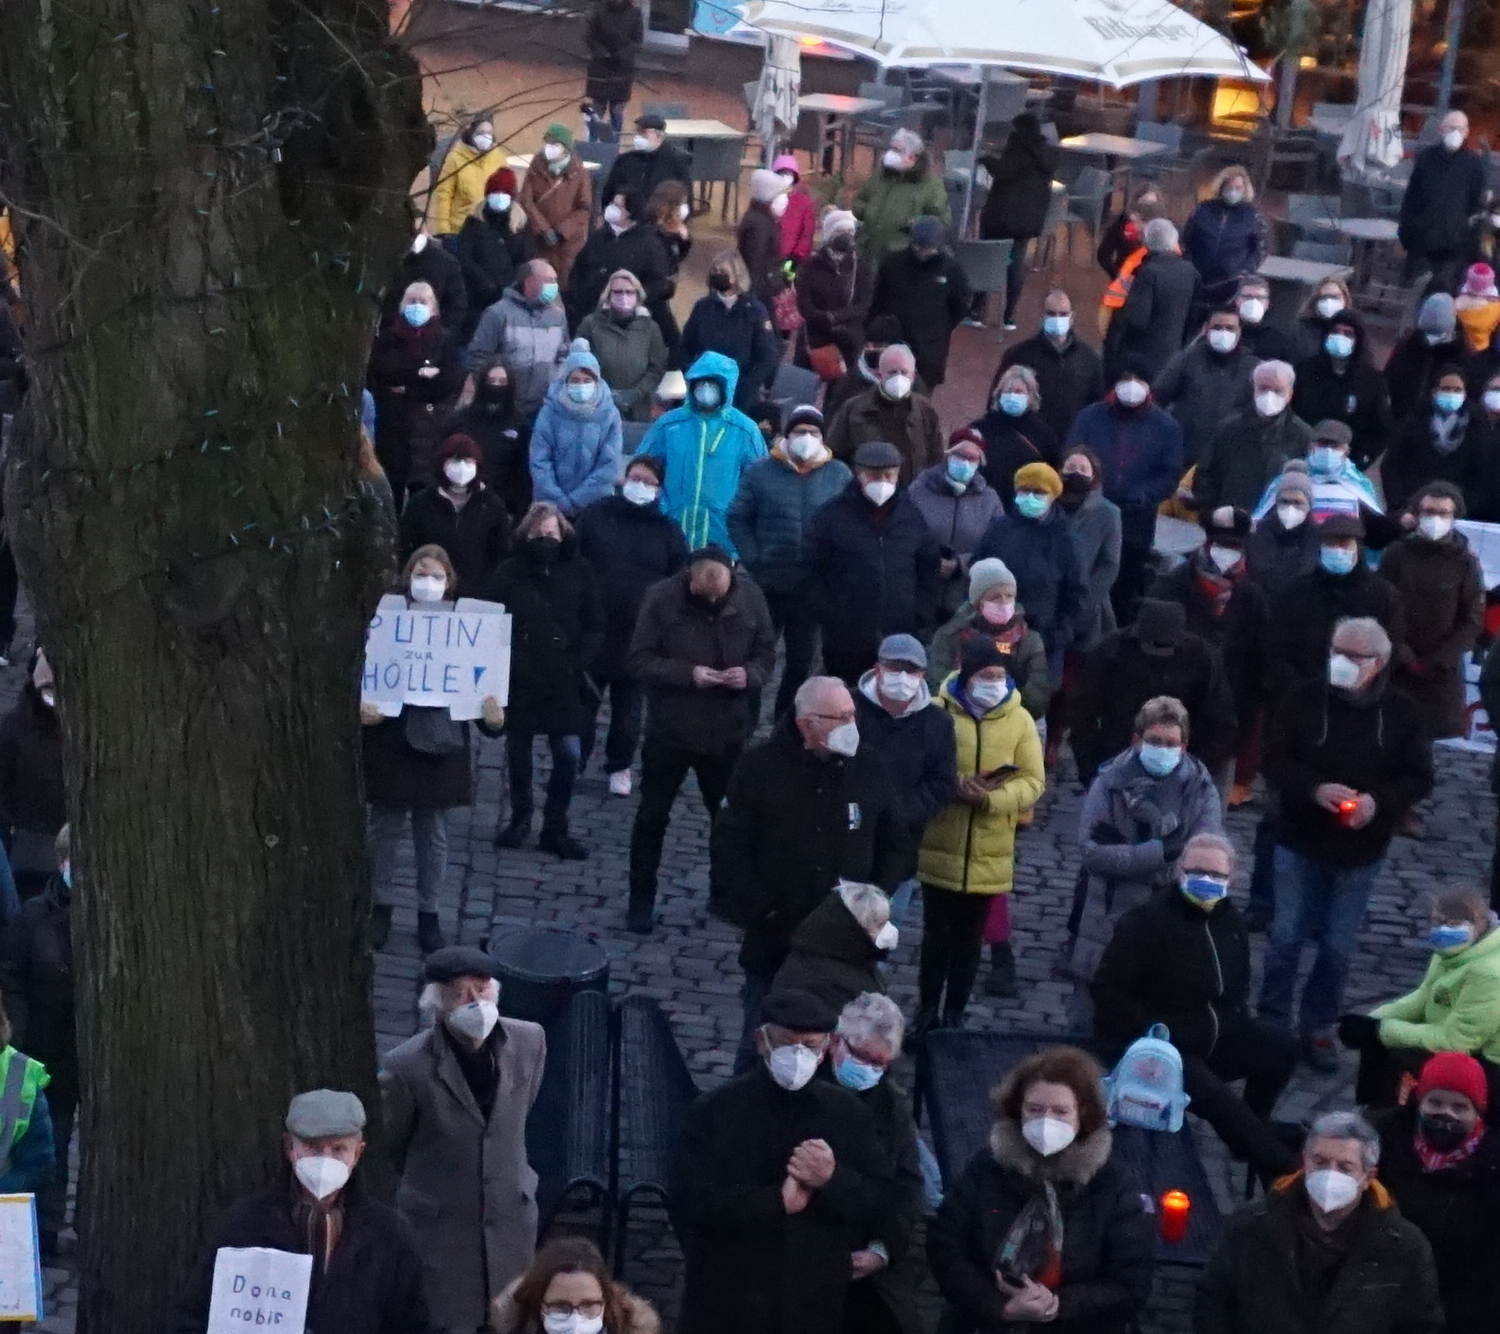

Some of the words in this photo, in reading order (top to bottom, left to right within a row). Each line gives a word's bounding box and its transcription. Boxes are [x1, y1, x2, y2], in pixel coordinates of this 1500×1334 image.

[365, 615, 482, 648] PUTIN
[233, 1274, 292, 1301] Dona
[230, 1307, 283, 1326] nobis
